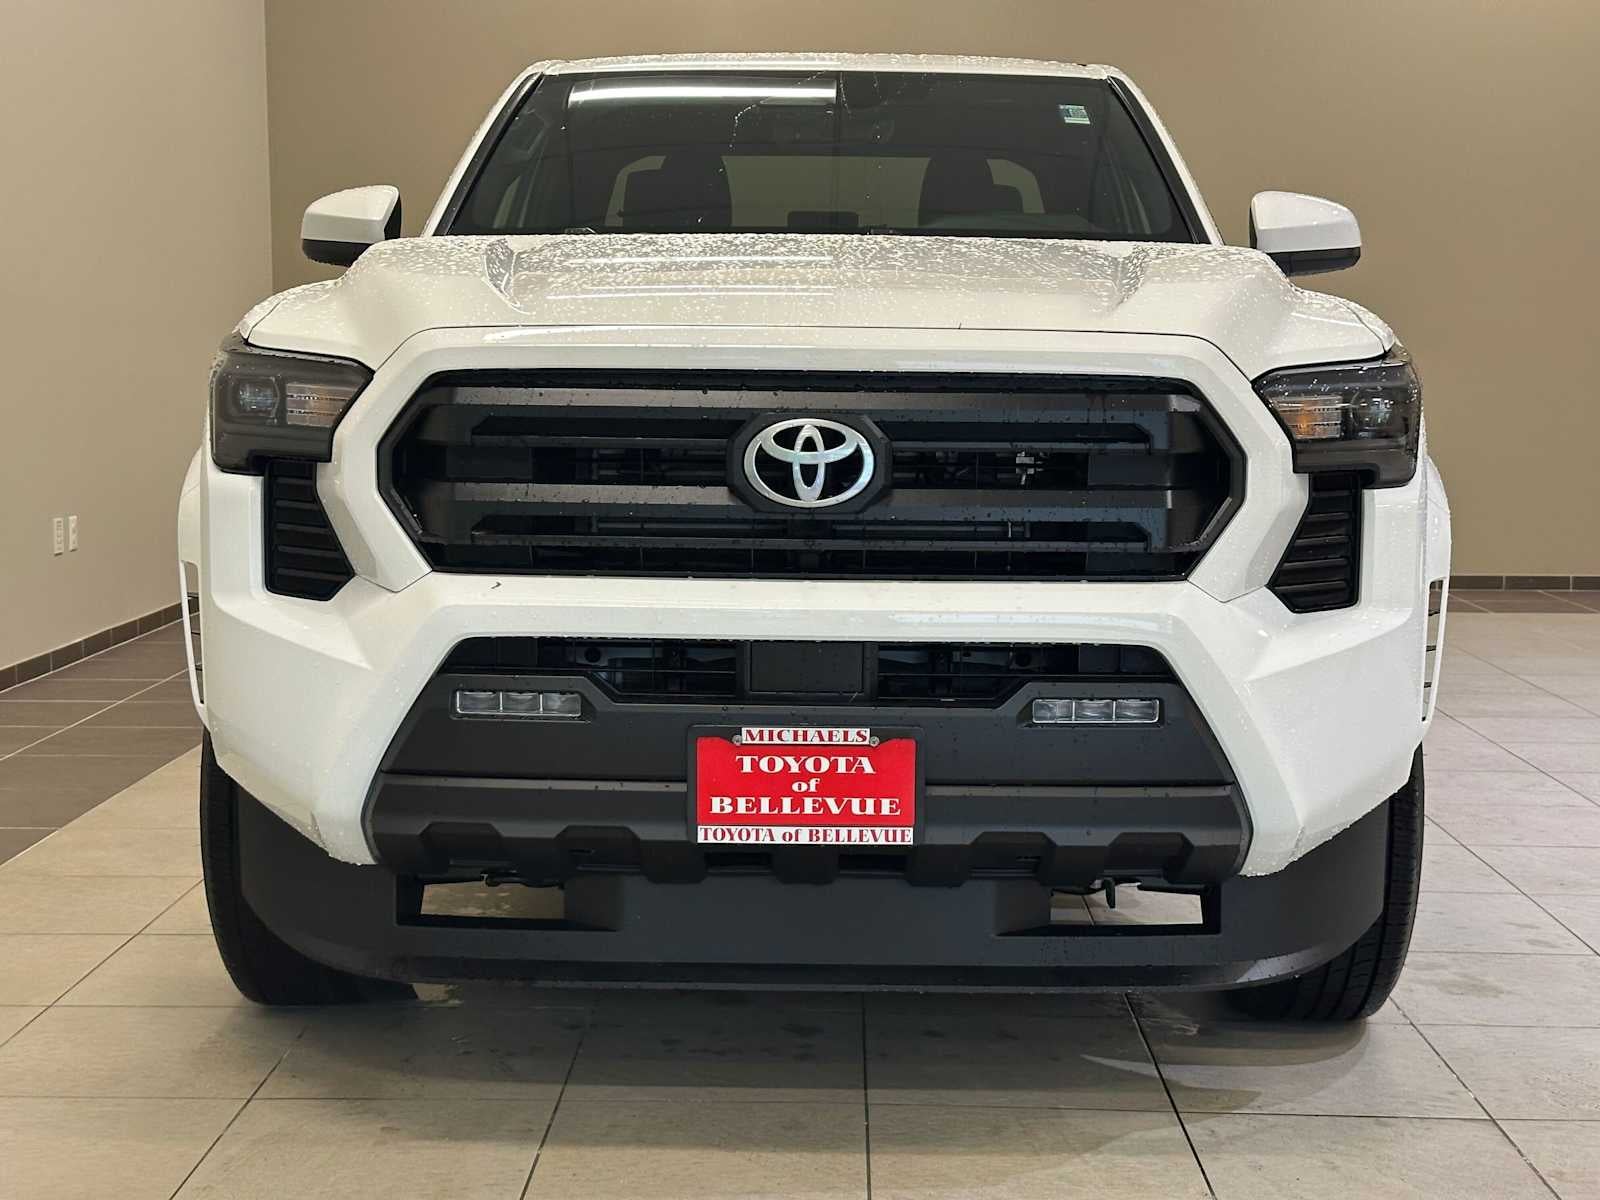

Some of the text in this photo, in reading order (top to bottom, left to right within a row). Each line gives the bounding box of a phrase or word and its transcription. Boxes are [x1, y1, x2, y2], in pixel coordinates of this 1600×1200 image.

[745, 729, 868, 743] MICHAELS
[736, 756, 876, 774] TOYOTA
[792, 778, 820, 793] of
[710, 796, 901, 816] BELLEVUE
[700, 827, 911, 843] TOYOTA of BELLEVUE
